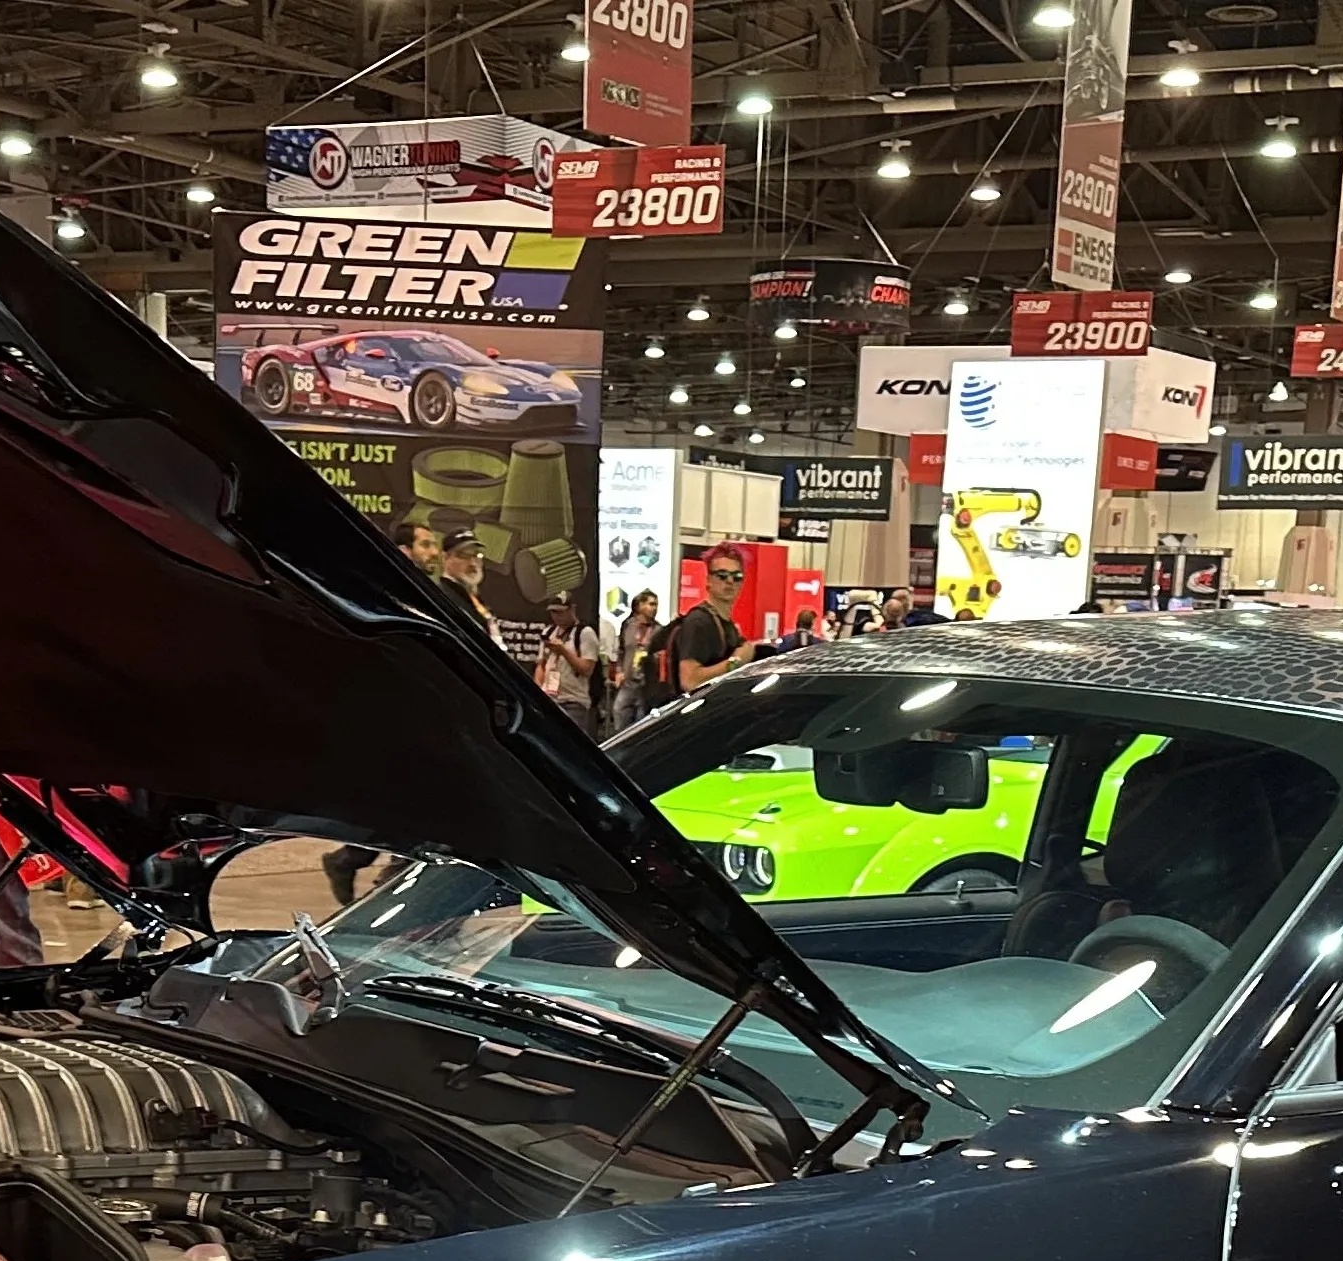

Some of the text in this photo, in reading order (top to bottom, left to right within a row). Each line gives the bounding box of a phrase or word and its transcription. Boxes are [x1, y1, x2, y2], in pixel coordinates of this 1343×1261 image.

[592, 0, 688, 49] 23800
[557, 160, 599, 179] SEMA
[592, 185, 721, 228] 23800
[1062, 169, 1115, 218] 23900
[239, 219, 514, 266] GREEN
[1074, 232, 1113, 265] ENEOS
[230, 260, 524, 308] FILTER USA
[234, 299, 557, 324] www.greenfilterusa.com
[1044, 321, 1148, 350] 23900
[293, 371, 315, 392] 68
[301, 441, 349, 461] ISN'T
[350, 444, 397, 464] JUST
[796, 463, 883, 488] vibrant
[798, 488, 880, 501] performance
